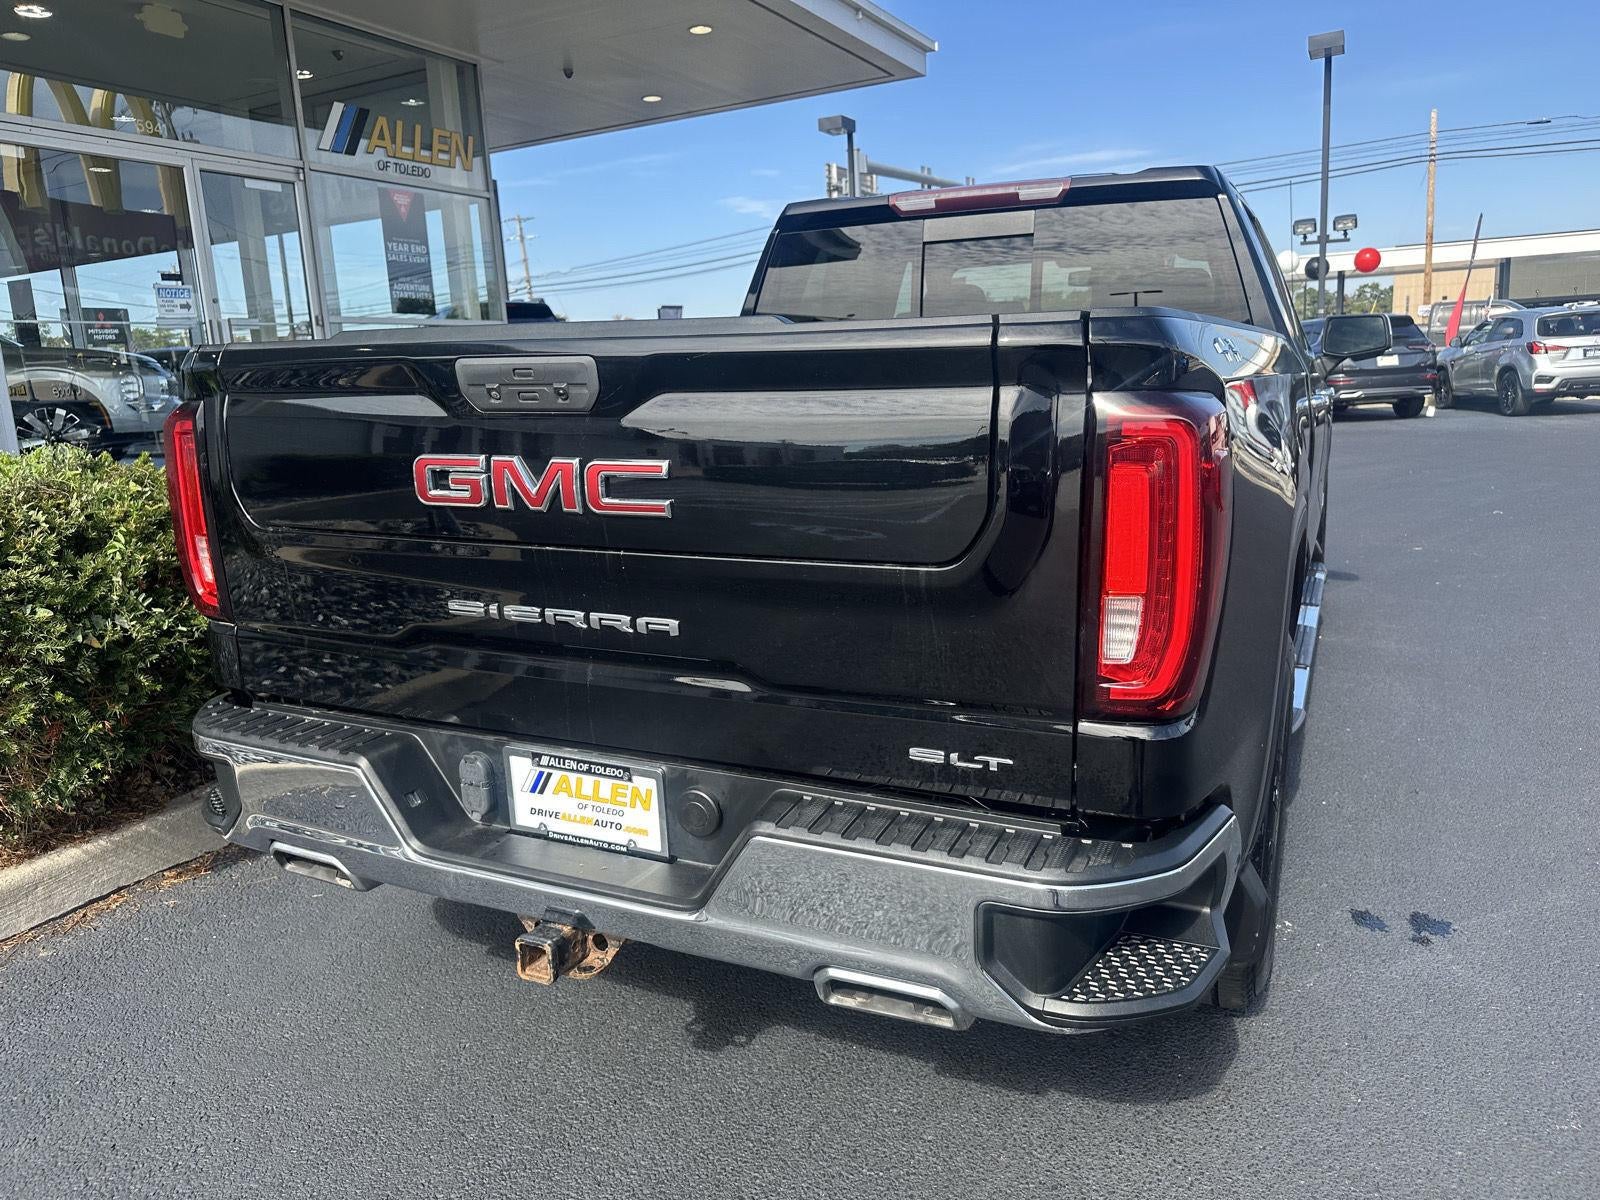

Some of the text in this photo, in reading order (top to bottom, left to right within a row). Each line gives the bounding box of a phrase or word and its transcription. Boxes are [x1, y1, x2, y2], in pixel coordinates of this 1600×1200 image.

[367, 115, 474, 172] ALLEN
[377, 159, 431, 179] OF TOLEDO
[387, 241, 427, 254] YEAR END
[387, 253, 429, 264] SALES EVENT
[159, 288, 190, 298] NOTICE
[413, 453, 672, 519] GMC
[448, 599, 680, 637] SIERRA
[548, 757, 624, 778] ALLEN OF TOLEDO
[908, 747, 1014, 772] SLT
[552, 774, 653, 811] ALLEN
[577, 802, 625, 817] OF TOLEDO
